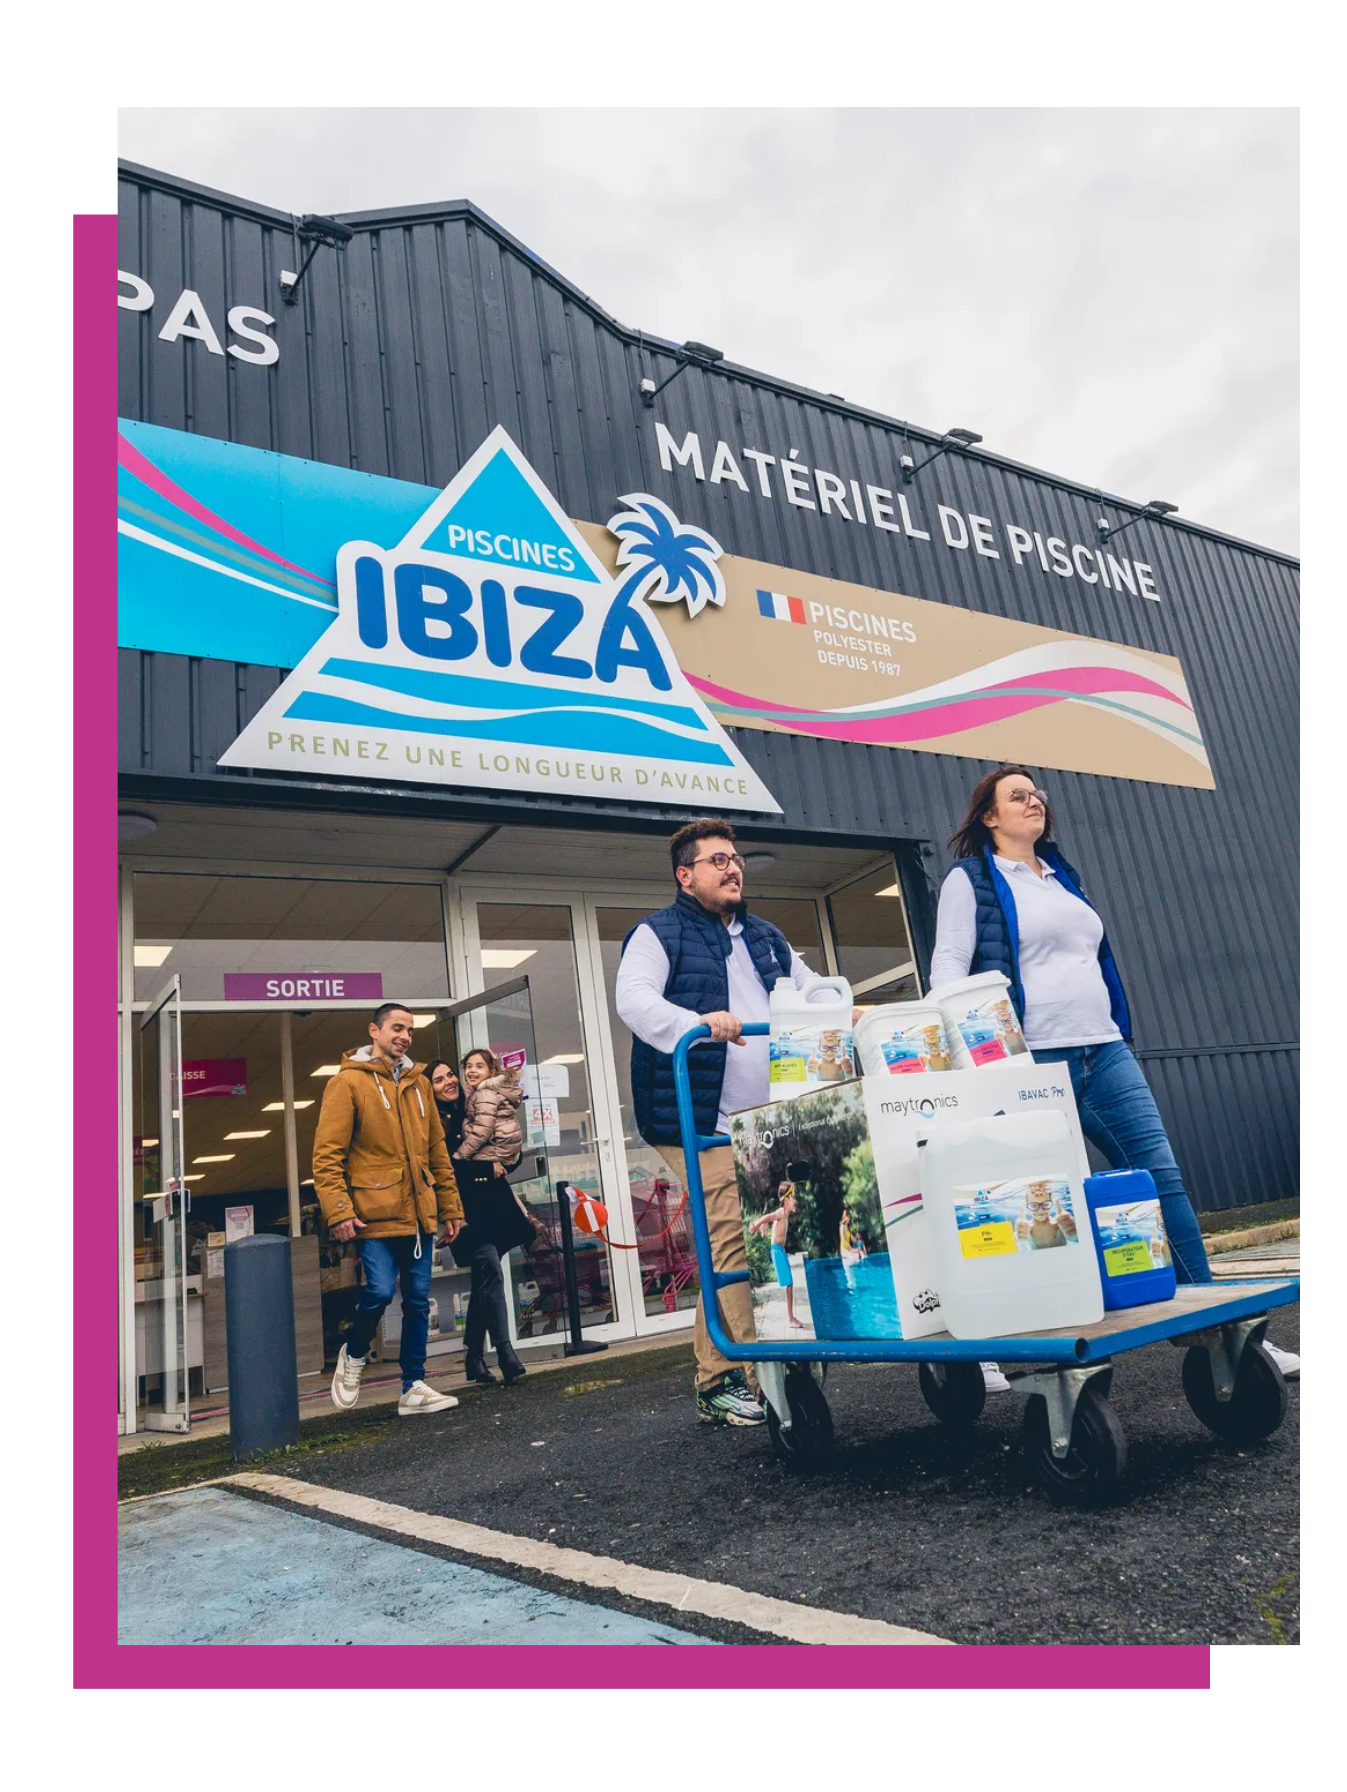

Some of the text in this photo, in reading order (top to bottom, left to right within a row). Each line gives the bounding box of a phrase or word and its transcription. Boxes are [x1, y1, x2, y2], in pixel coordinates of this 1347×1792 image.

[654, 421, 1161, 602] MATÉRIEL DE PISCINE
[447, 524, 576, 572] PISCINES
[354, 555, 673, 692] IBIZA
[808, 600, 918, 644] PISCINES
[813, 629, 893, 657] POLYESTER
[817, 649, 901, 677] DEPUIS 1987
[267, 731, 749, 796] PRENEZ UNE LONGUEUR D'AVANCE
[266, 979, 345, 998] SORTIE
[880, 1093, 959, 1117] maytronics
[1018, 1088, 1049, 1102] IBAVAC
[738, 1125, 790, 1148] maytronics
